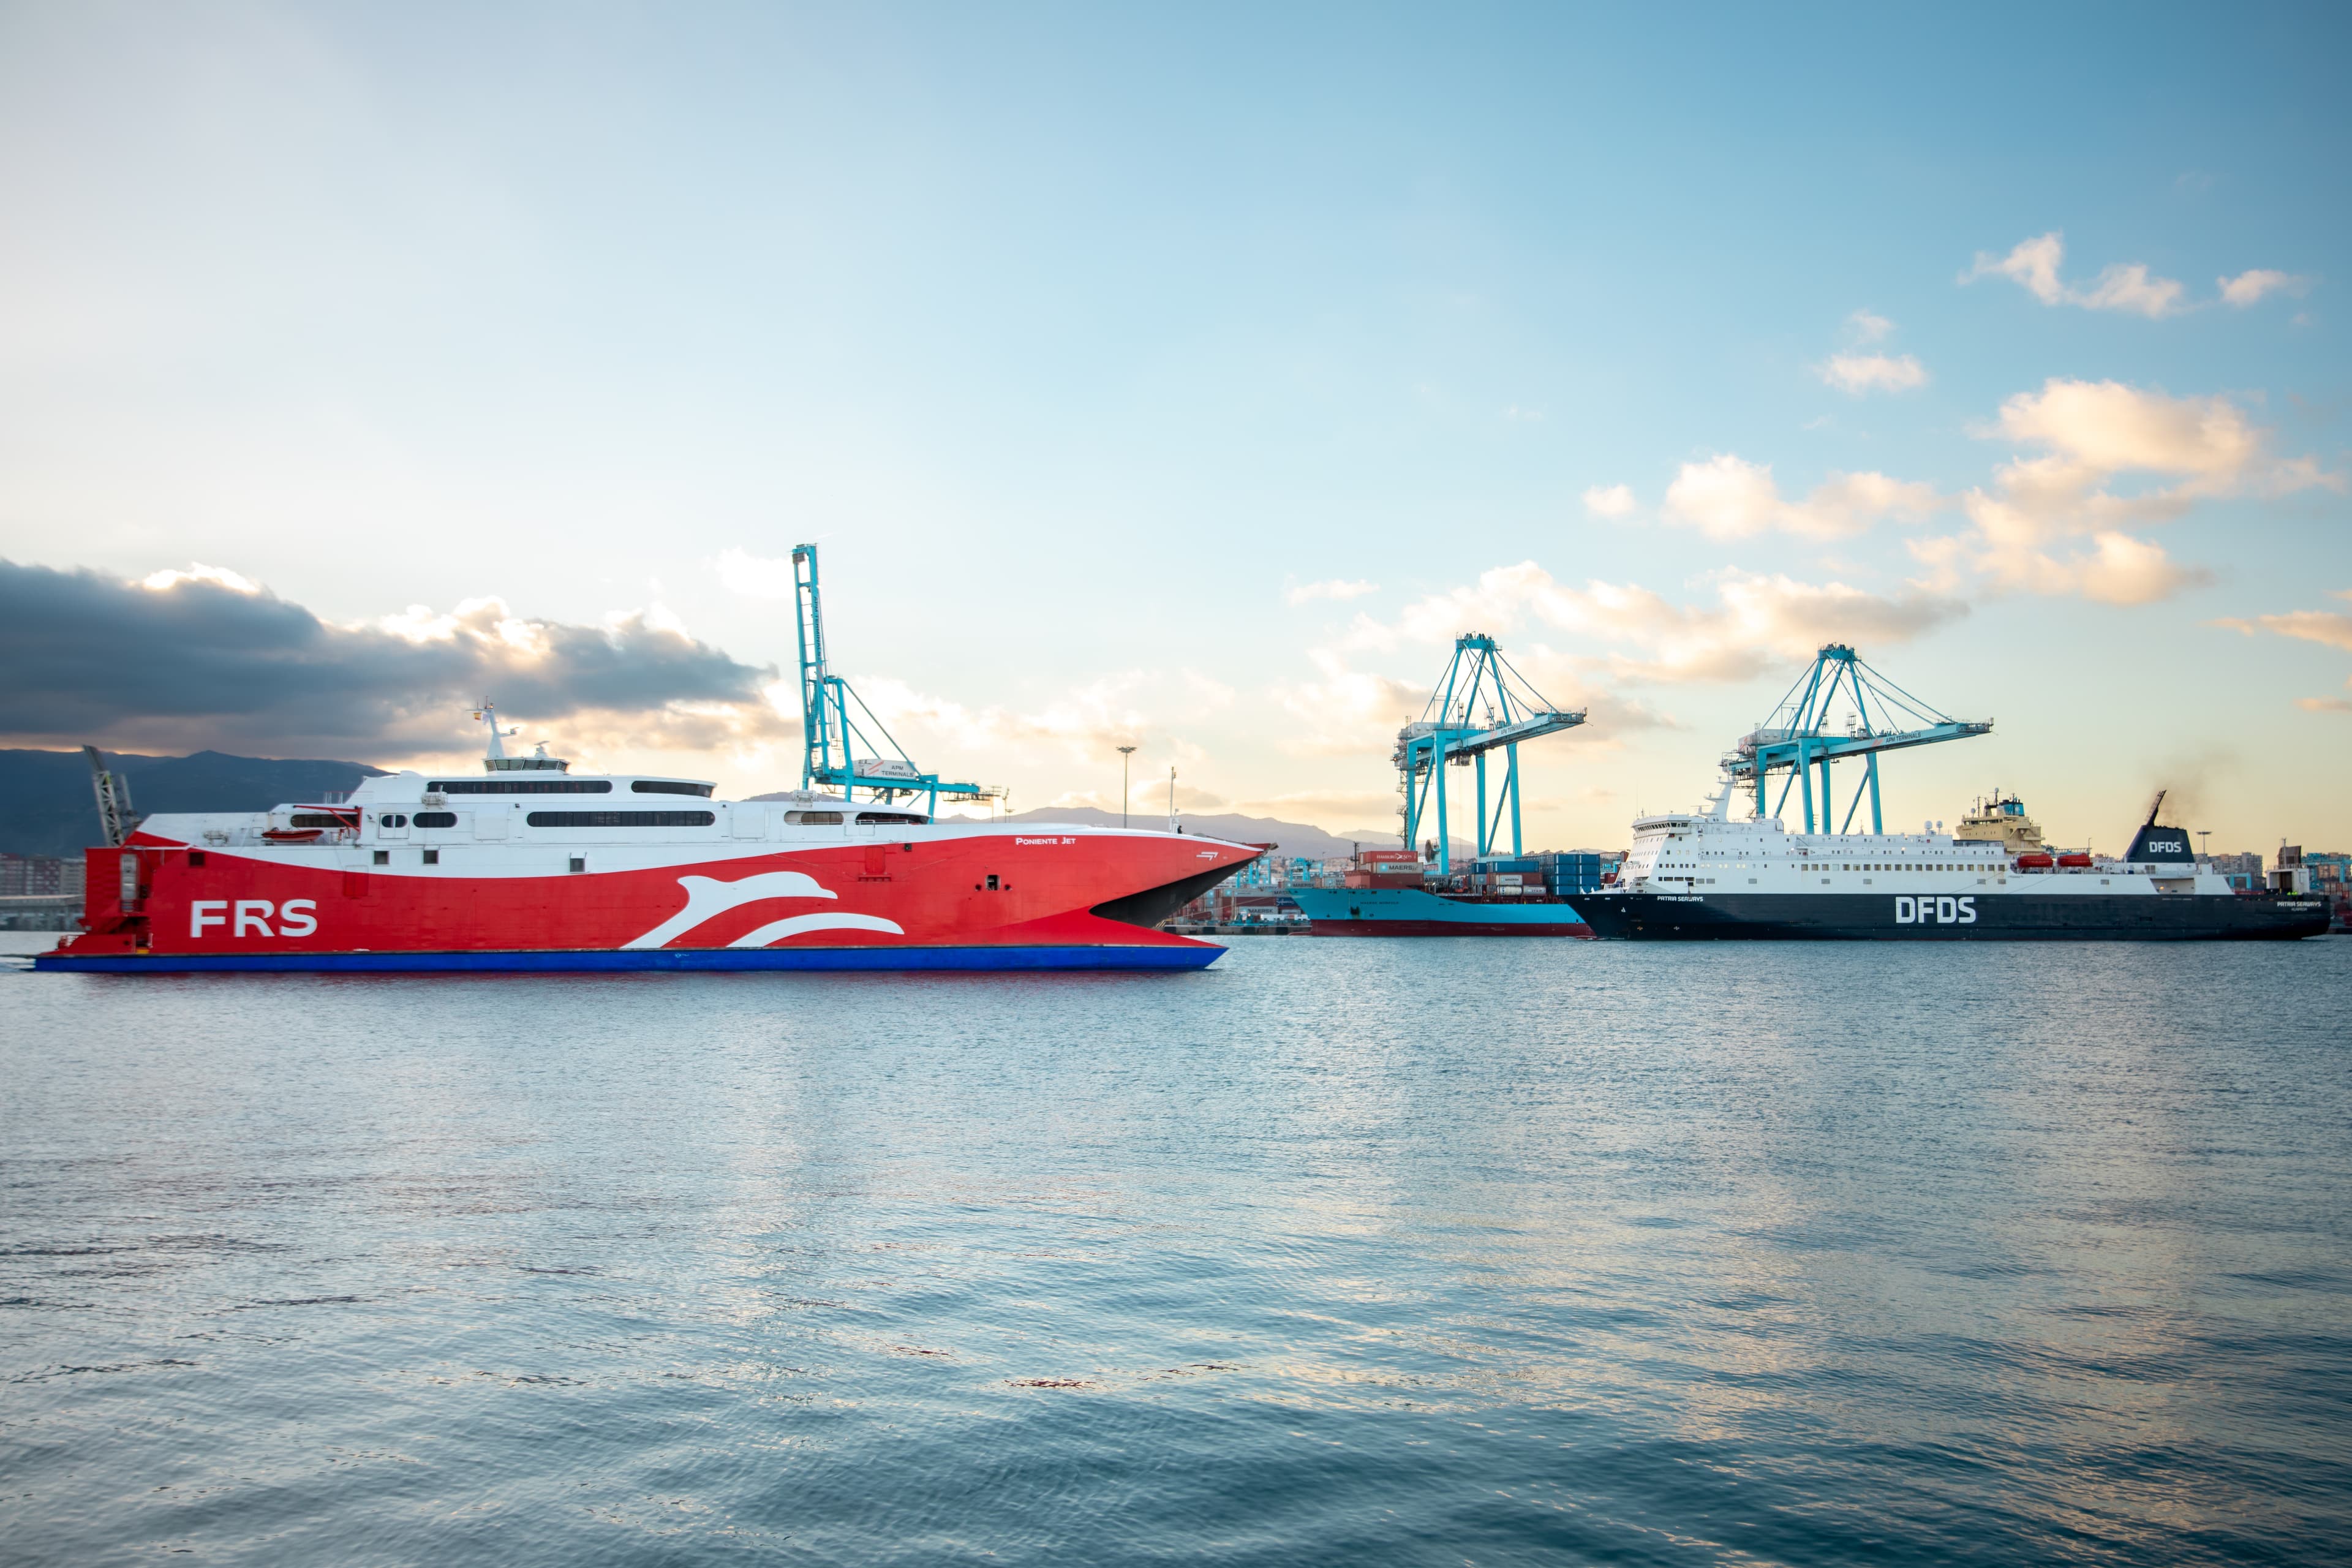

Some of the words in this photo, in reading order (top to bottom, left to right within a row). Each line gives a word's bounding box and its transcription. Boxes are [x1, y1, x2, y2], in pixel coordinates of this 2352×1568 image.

[1507, 723, 1525, 733] TERMINALS
[1896, 732, 1921, 741] TERMINALS
[2149, 842, 2182, 853] DFDS
[1896, 897, 1976, 923] DFDS
[190, 899, 317, 938] FRS
